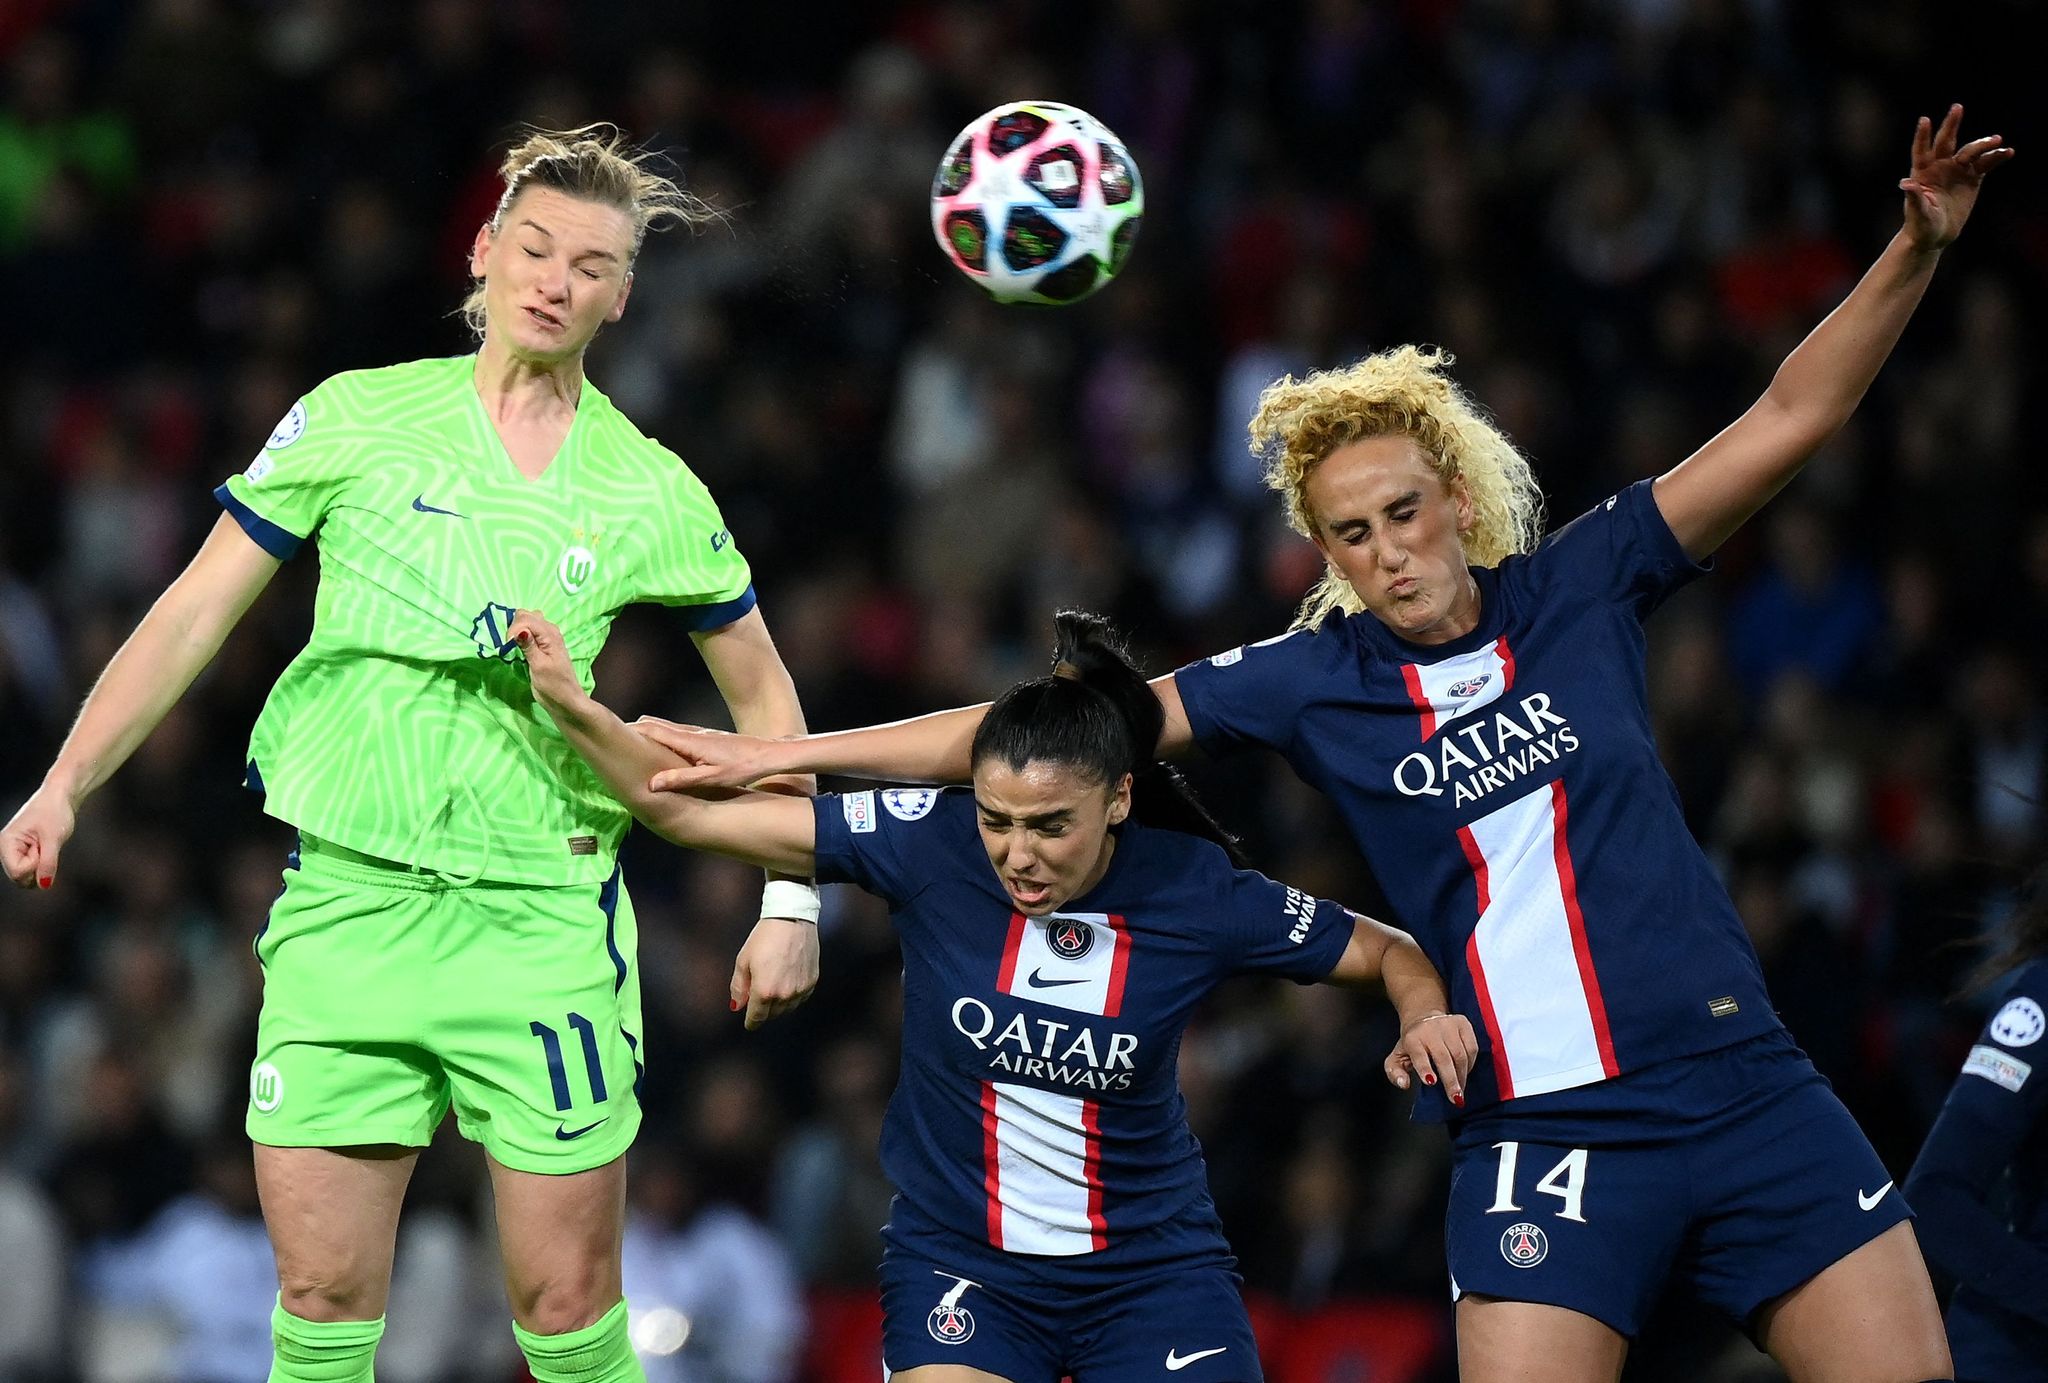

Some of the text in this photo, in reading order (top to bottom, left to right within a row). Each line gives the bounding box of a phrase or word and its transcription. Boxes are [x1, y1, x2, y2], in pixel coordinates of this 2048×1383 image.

[1393, 692, 1567, 797] QATAR
[1454, 726, 1580, 809] AIRWAYS
[529, 1012, 608, 1112] 11
[951, 996, 1139, 1070] QATAR
[989, 1051, 1133, 1091] AIRWAYS
[1485, 1141, 1589, 1223] 14
[1508, 1225, 1540, 1237] PARIS
